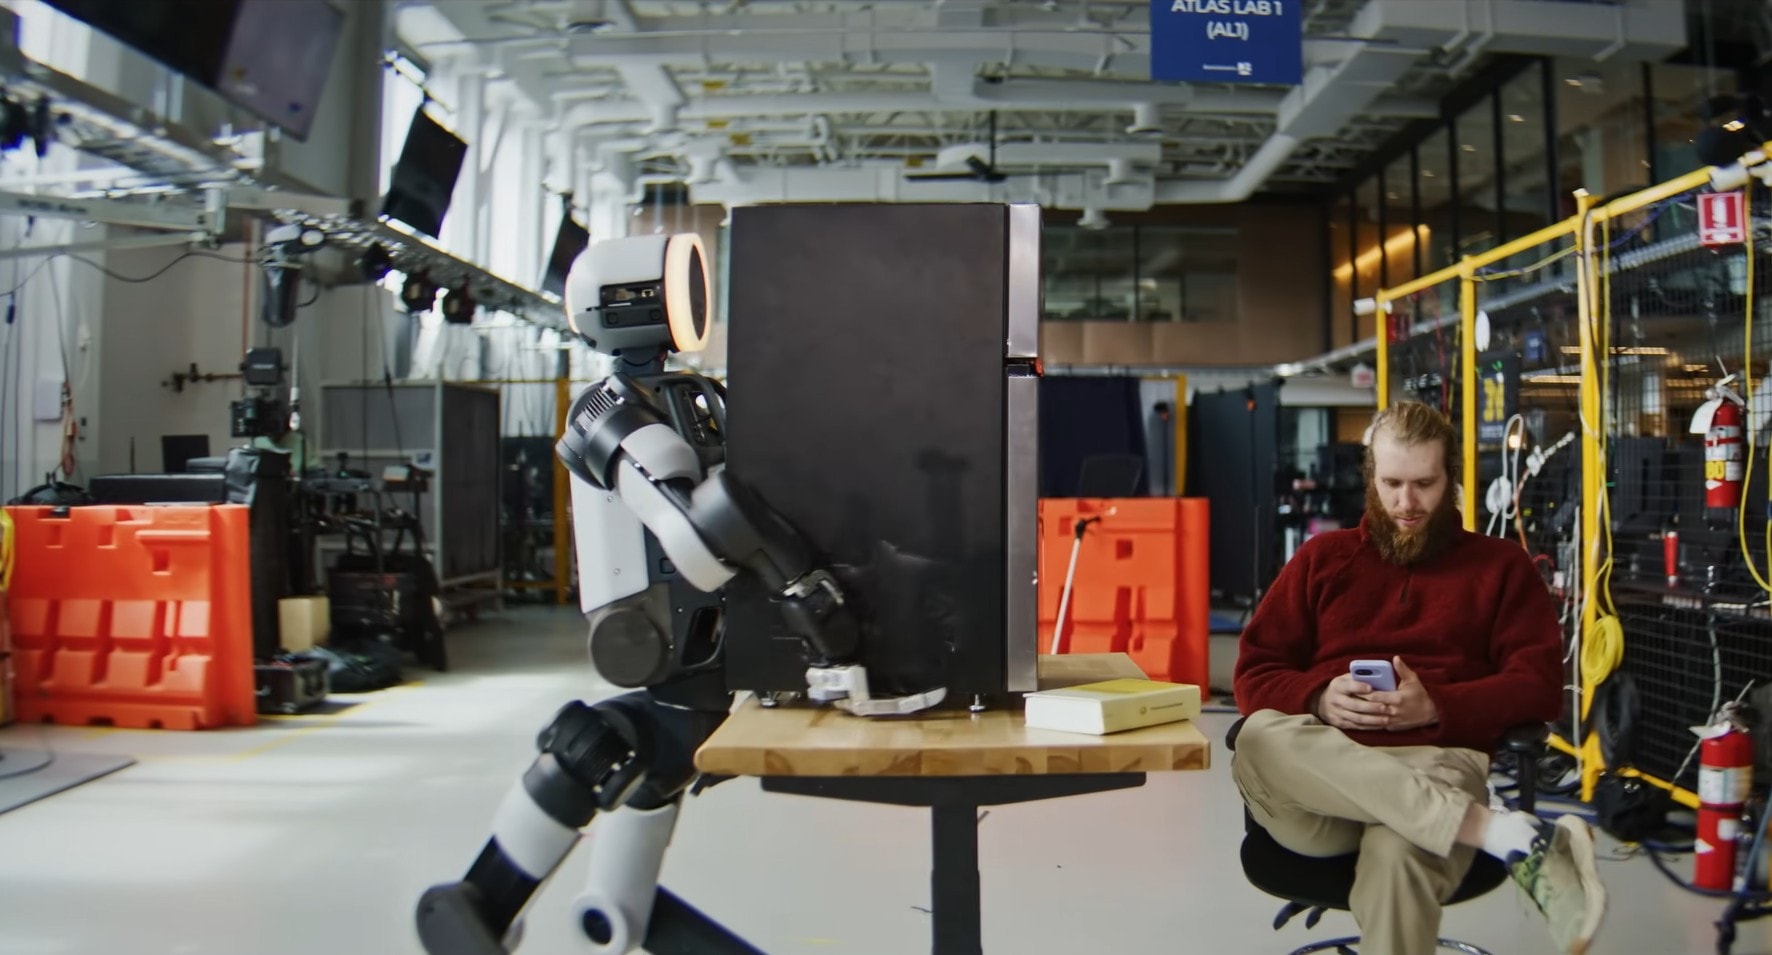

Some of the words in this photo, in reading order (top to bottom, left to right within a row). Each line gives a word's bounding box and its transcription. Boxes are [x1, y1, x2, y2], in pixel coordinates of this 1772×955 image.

[1171, 0, 1232, 14] ATLAS
[1233, 0, 1272, 15] LAB
[1273, 1, 1283, 16] 1
[1206, 20, 1249, 41] (AL1)
